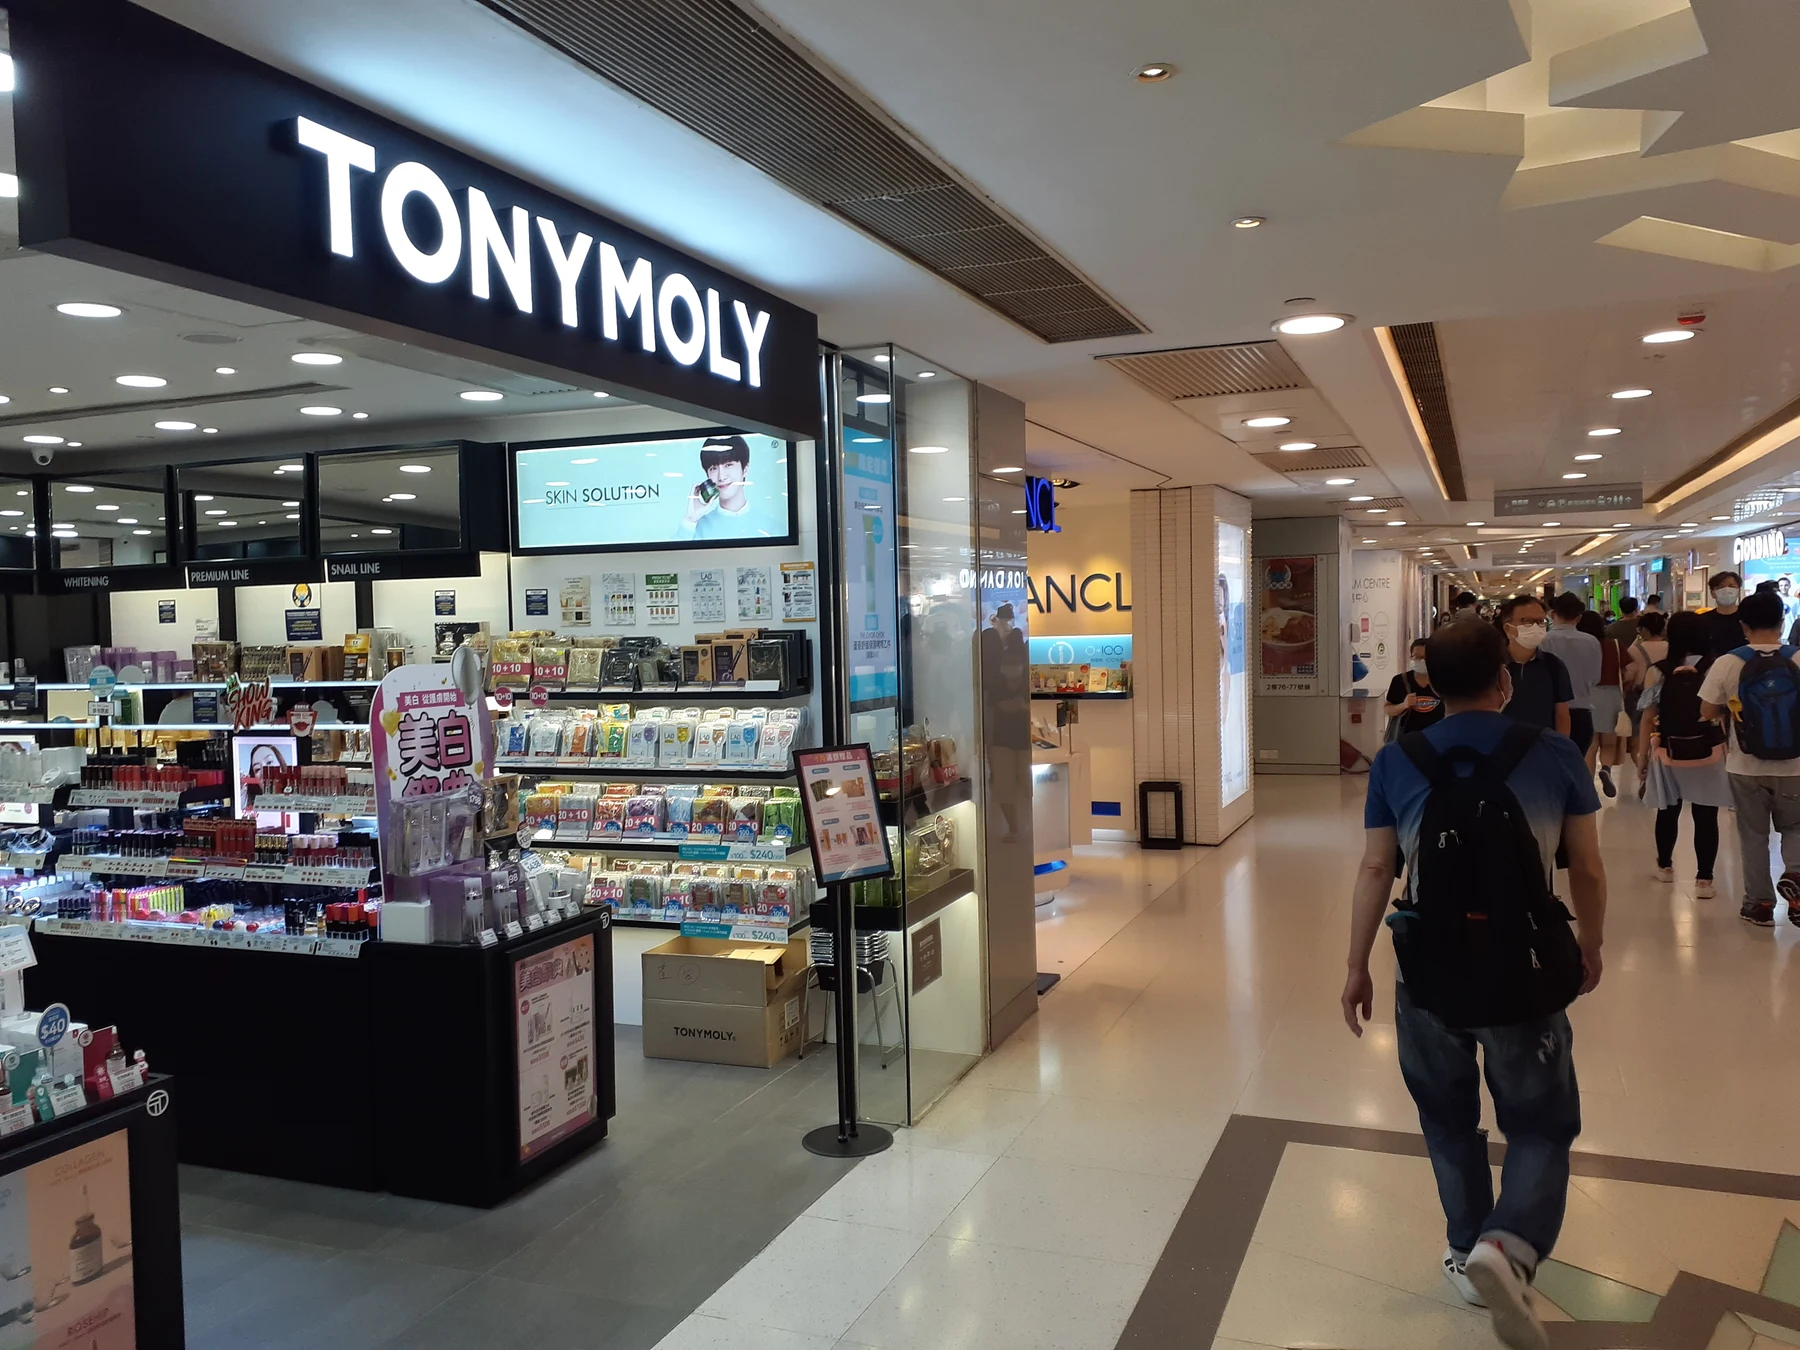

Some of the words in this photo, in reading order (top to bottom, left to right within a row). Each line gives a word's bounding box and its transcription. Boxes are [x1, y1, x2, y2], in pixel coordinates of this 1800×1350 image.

[296, 115, 772, 389] TONYMOLY
[545, 489, 577, 505] SKIN
[582, 483, 660, 502] SOLUTION
[190, 570, 228, 583] PREMIUM
[231, 568, 250, 581] LINE
[331, 563, 357, 576] SNAIL
[359, 562, 381, 575] LINE
[64, 575, 109, 588] WHITENING
[1363, 577, 1391, 589] CENTRE
[492, 664, 502, 673] 10
[509, 663, 521, 673] 10
[534, 667, 543, 676] 10
[552, 666, 564, 676] 10
[398, 709, 473, 776] 美白
[558, 811, 567, 820] 20
[576, 810, 588, 819] 10
[750, 850, 773, 860] $240
[611, 888, 623, 898] 10
[751, 931, 776, 941] $240
[40, 1017, 66, 1040] $40
[673, 1026, 734, 1041] TONYMOLY
